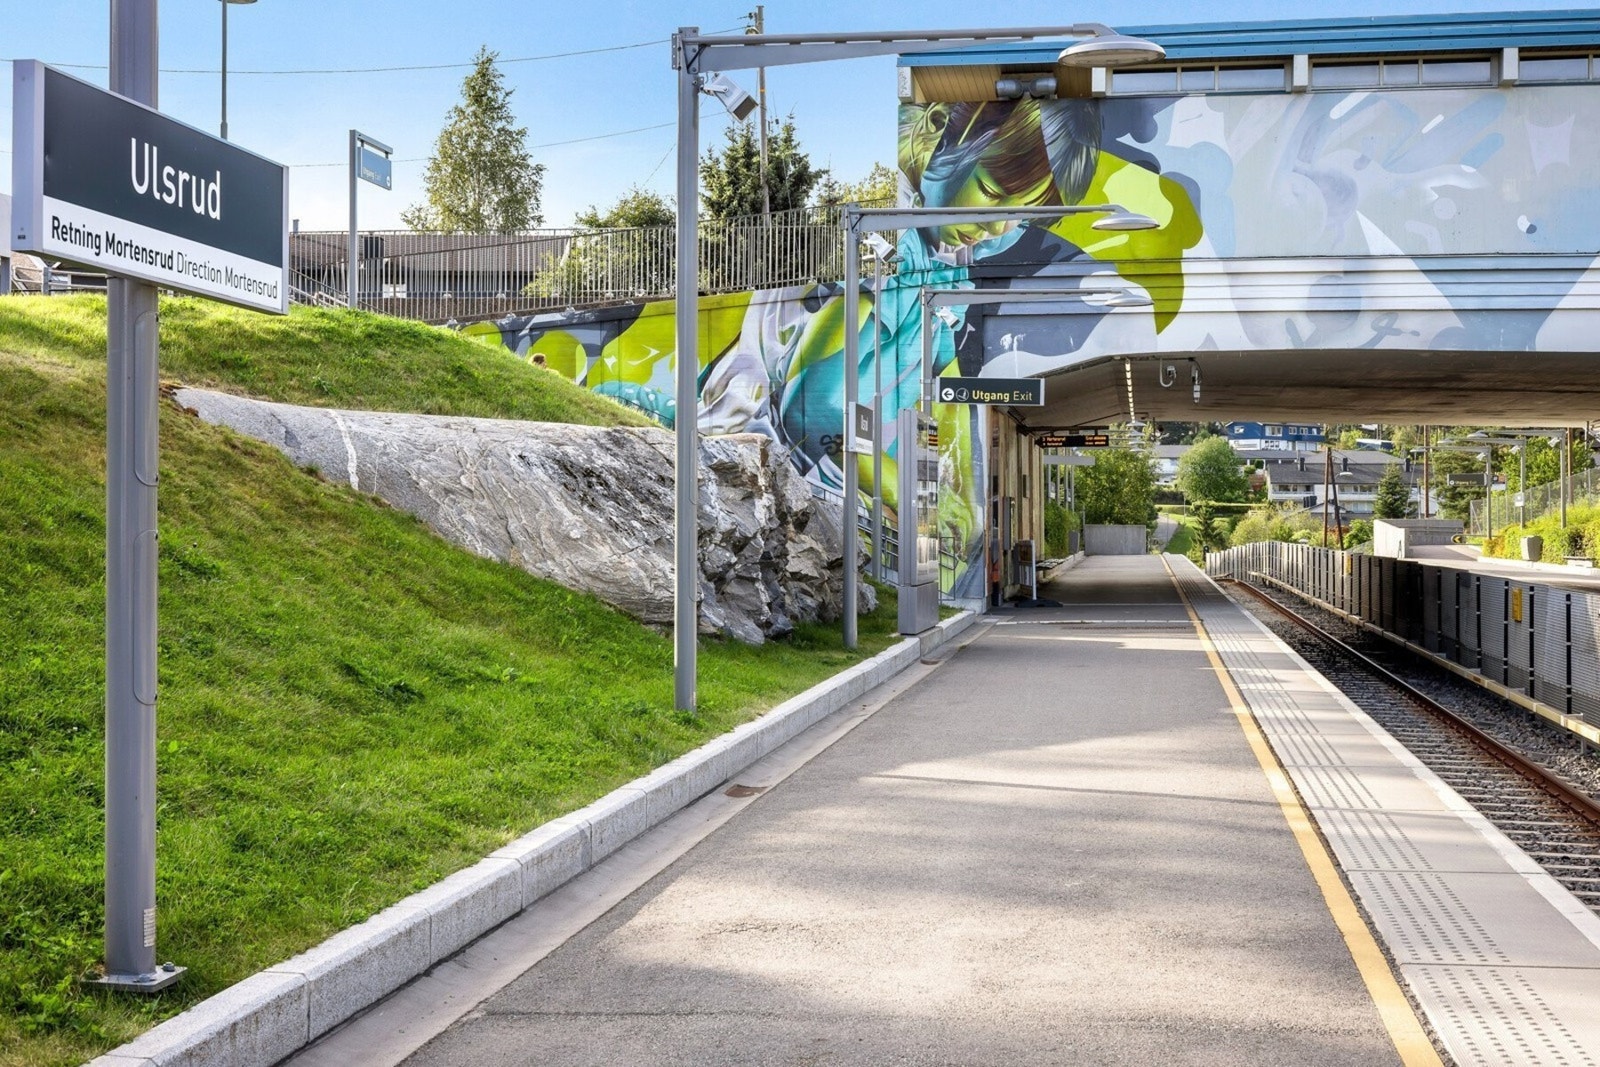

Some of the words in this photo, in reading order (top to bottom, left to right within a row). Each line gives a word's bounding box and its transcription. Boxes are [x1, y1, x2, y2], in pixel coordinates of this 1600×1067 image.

[130, 137, 221, 221] Ulsrud
[51, 215, 101, 257] Retning
[105, 231, 174, 271] Mortensrud
[176, 252, 222, 284] Direction
[224, 265, 278, 299] Mortensrud
[971, 390, 1010, 402] Utgang
[1013, 390, 1032, 401] Exit
